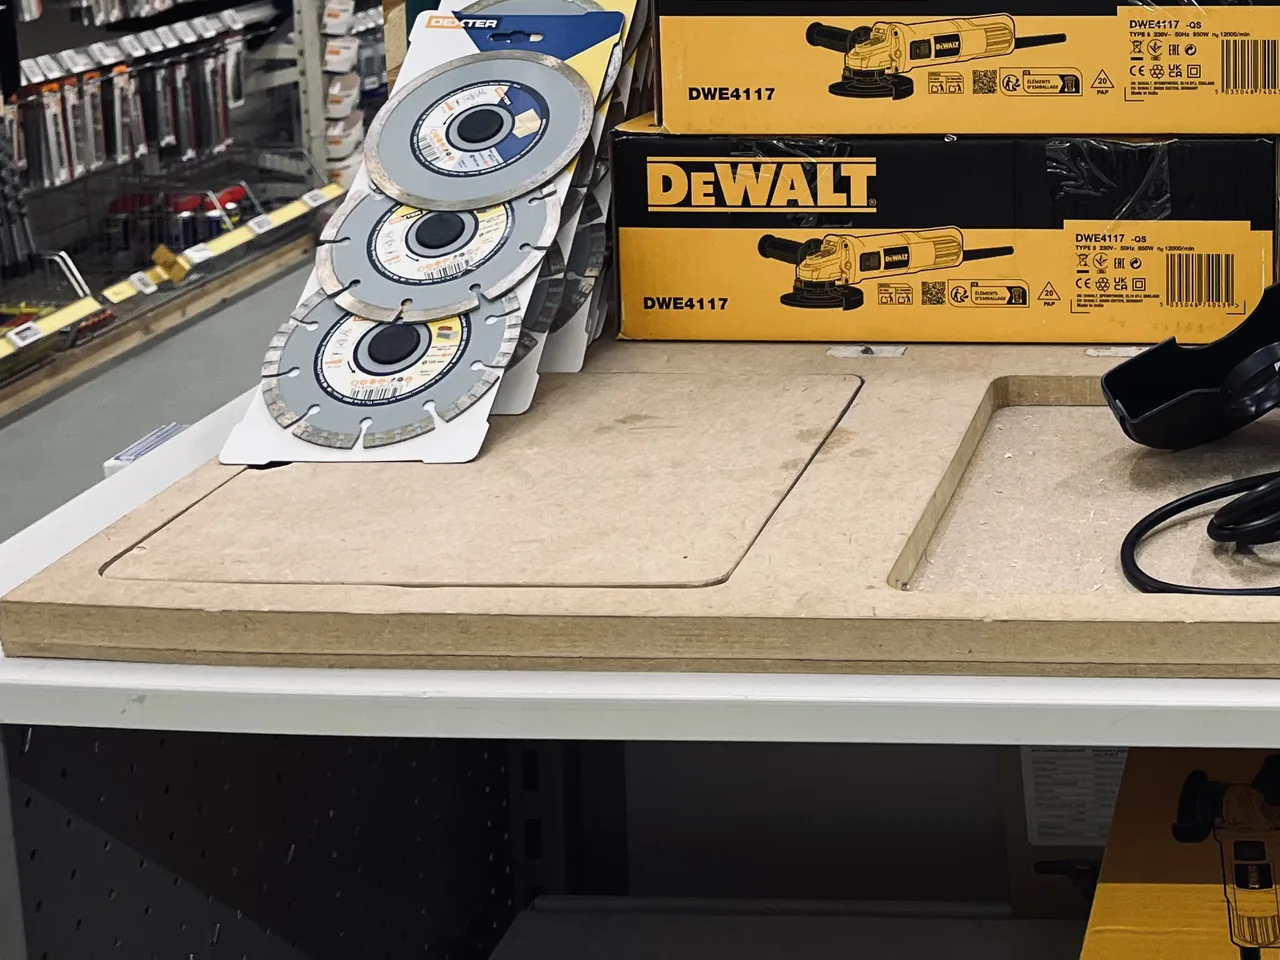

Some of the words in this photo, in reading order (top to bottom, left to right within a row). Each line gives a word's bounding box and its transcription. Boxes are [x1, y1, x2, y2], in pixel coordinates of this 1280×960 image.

[430, 17, 498, 28] DEXTER
[1129, 20, 1180, 29] DWE4117
[1186, 21, 1202, 29] -QS
[688, 87, 776, 101] DWE4117
[1075, 234, 1125, 243] DWE4117
[1131, 235, 1147, 243] -QS
[642, 296, 728, 310] DWE4117
